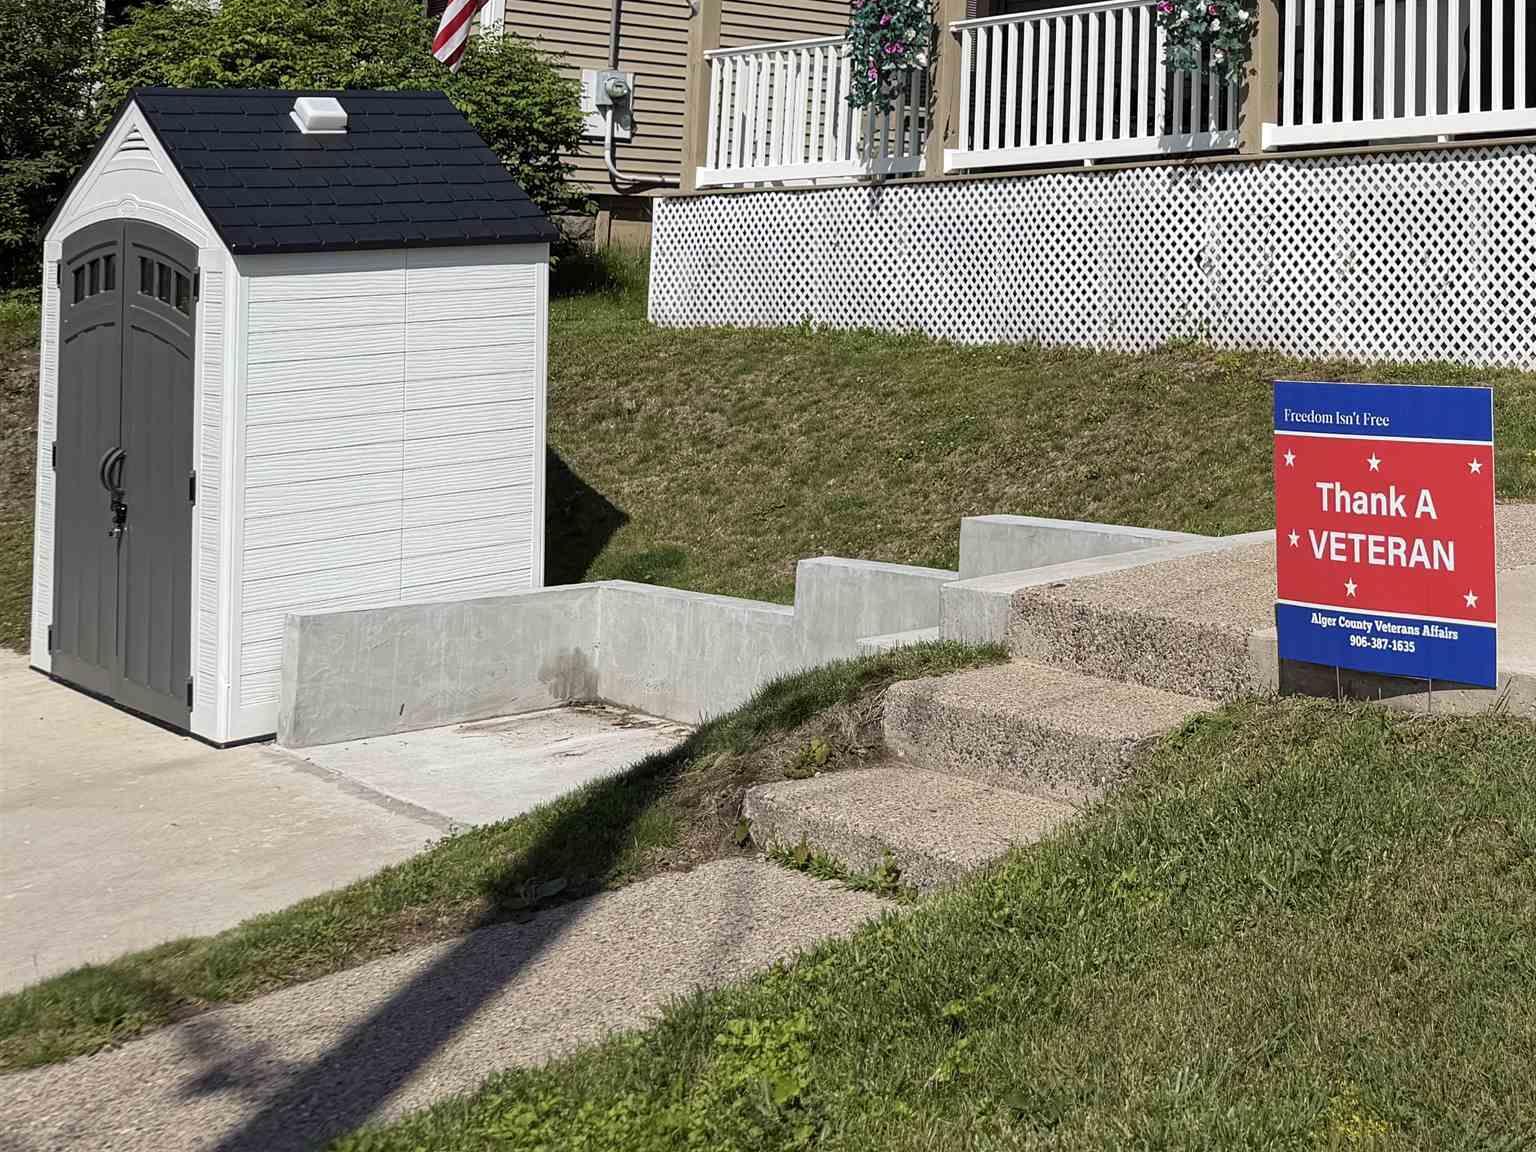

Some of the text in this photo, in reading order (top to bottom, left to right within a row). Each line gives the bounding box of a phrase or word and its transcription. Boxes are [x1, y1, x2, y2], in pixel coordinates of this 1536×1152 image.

[1284, 408, 1390, 427] Freedom Isn't Free
[1315, 481, 1438, 520] Thank A
[1307, 529, 1455, 571] VETERAN
[1311, 612, 1458, 640] Alger County Veterans Affairs
[1349, 634, 1416, 653] 906-387-1635
